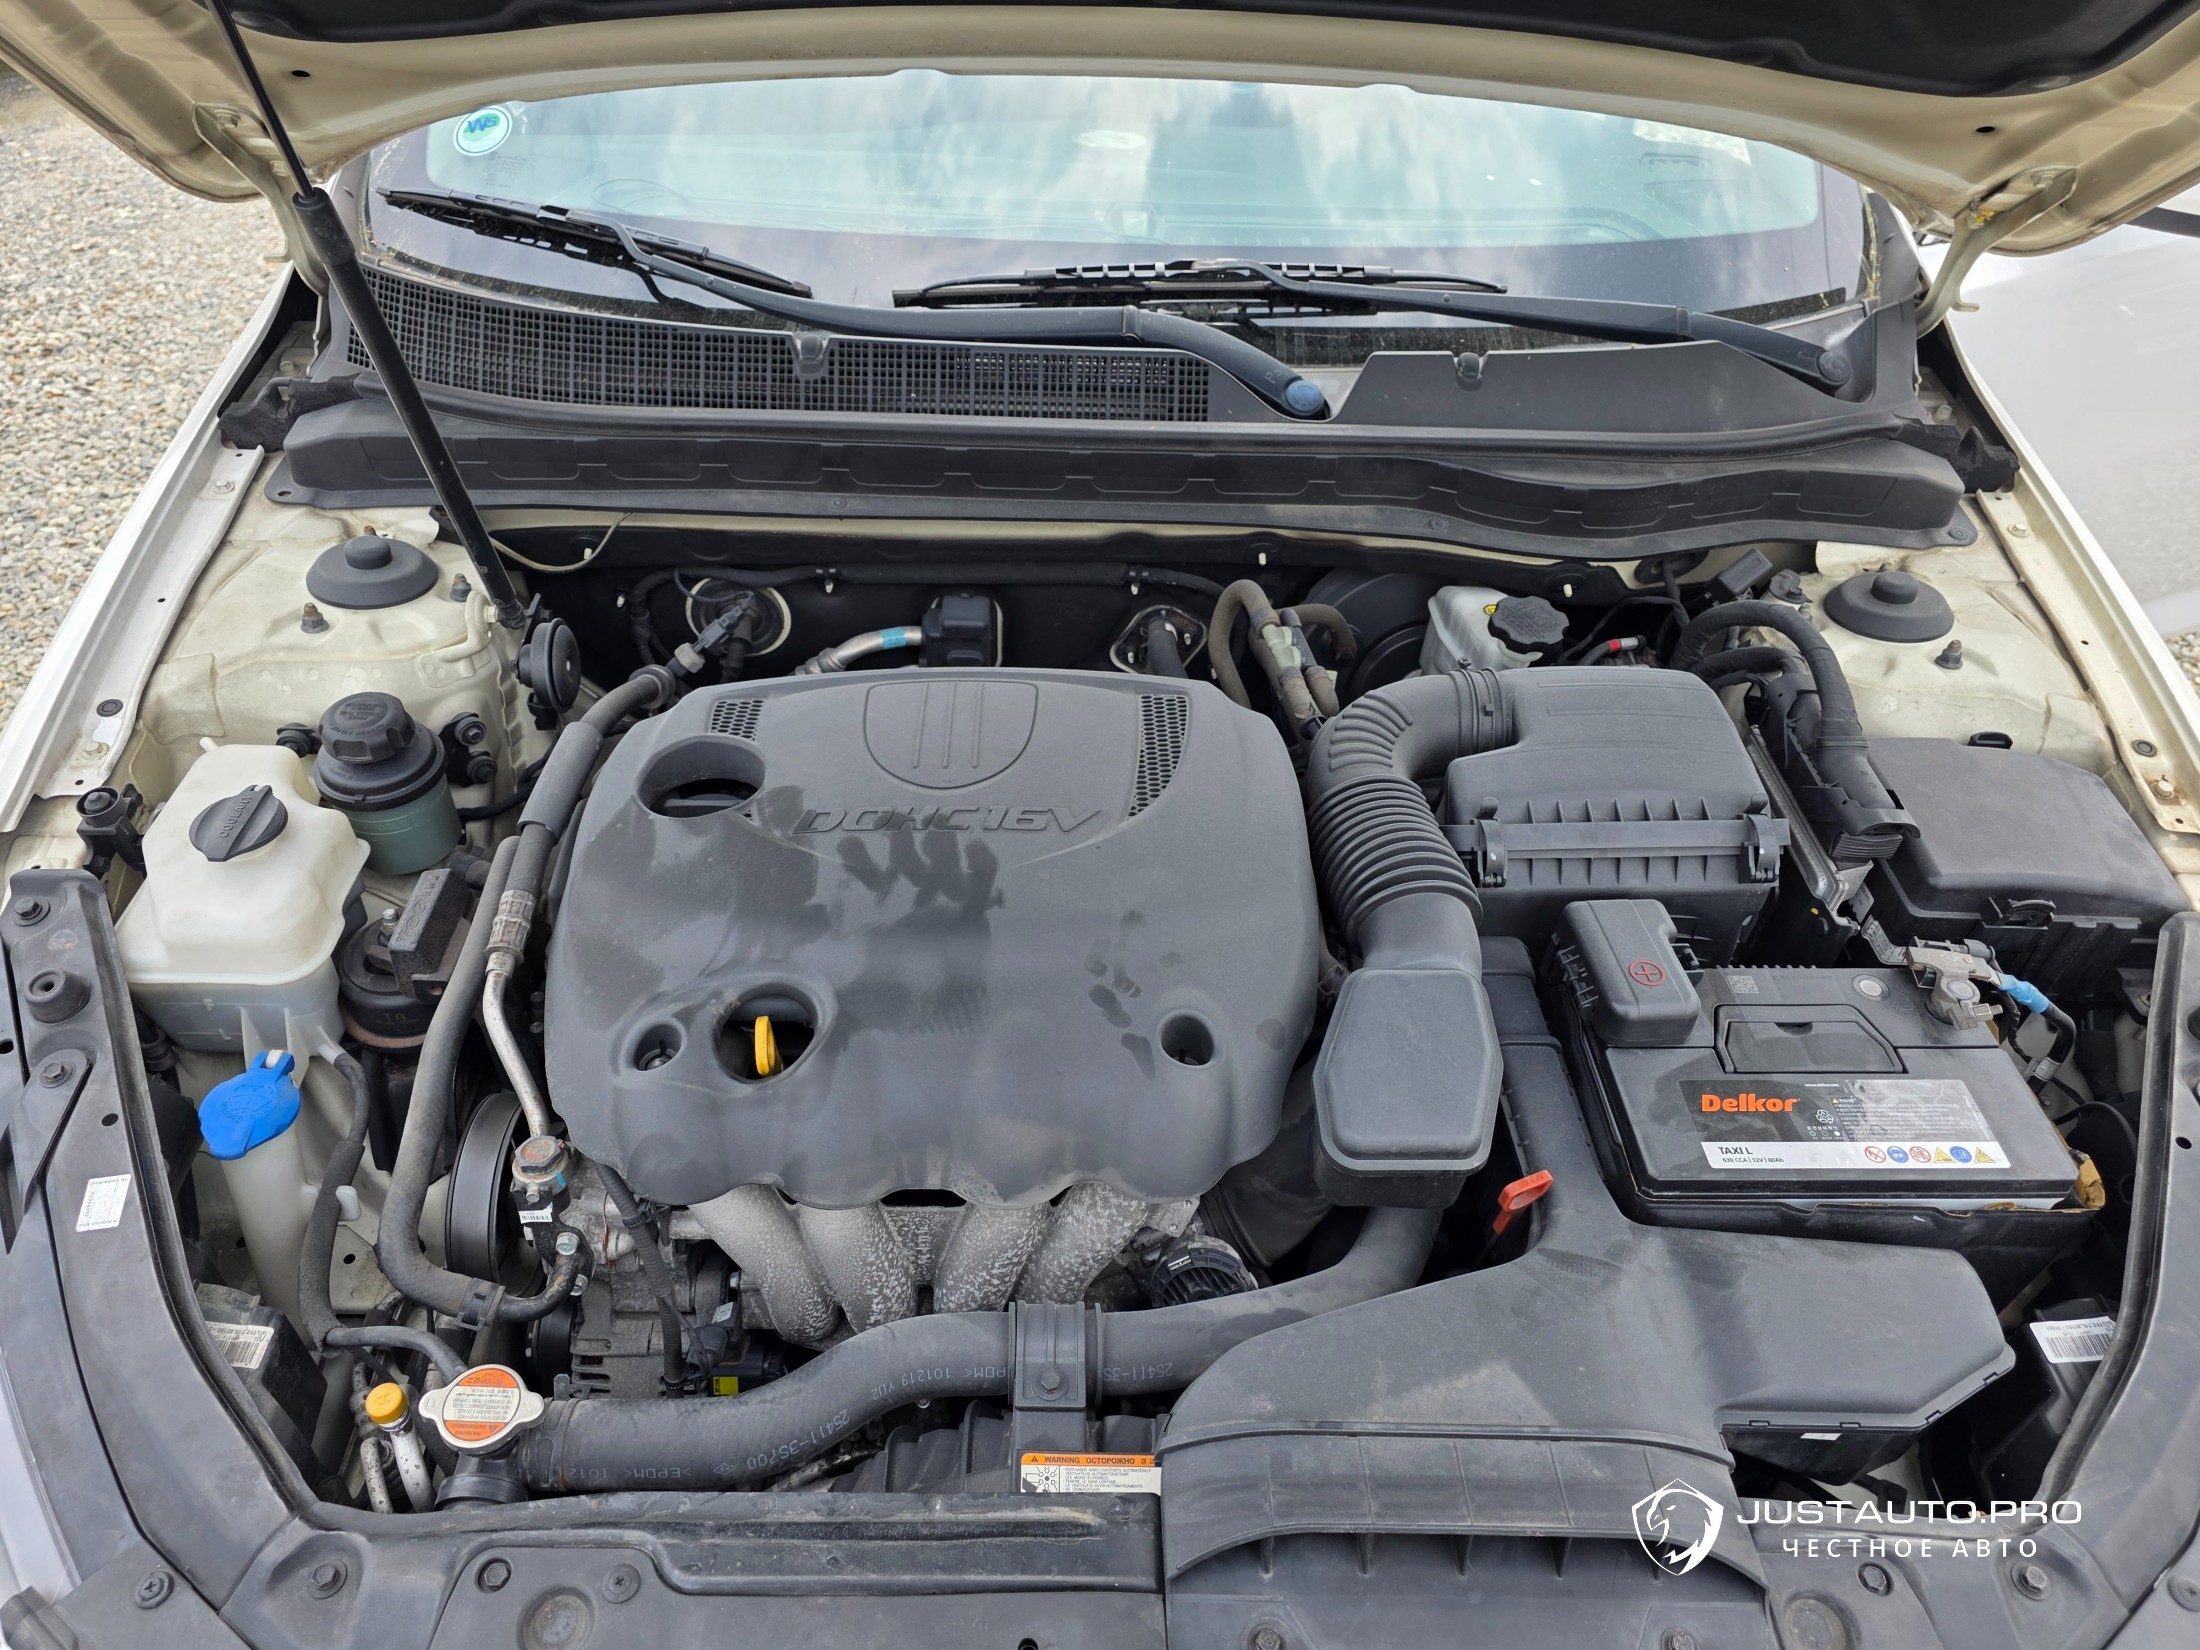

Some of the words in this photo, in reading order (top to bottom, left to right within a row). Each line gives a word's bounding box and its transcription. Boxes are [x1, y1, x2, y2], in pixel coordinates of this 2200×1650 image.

[219, 796, 253, 838] COOLANT
[1701, 1093, 1798, 1112] Delkor
[1717, 1146, 1743, 1155] TAXI
[1745, 1146, 1753, 1155] L
[901, 1367, 952, 1387] 101219
[1102, 1361, 1174, 1382] 25411-3S
[871, 1380, 895, 1401] YU2
[746, 1409, 851, 1471] 25411-3S700
[1044, 1455, 1080, 1463] WARNING
[1086, 1457, 1135, 1465] ОСТОРОЖНО
[624, 1466, 692, 1479] >EPDM<
